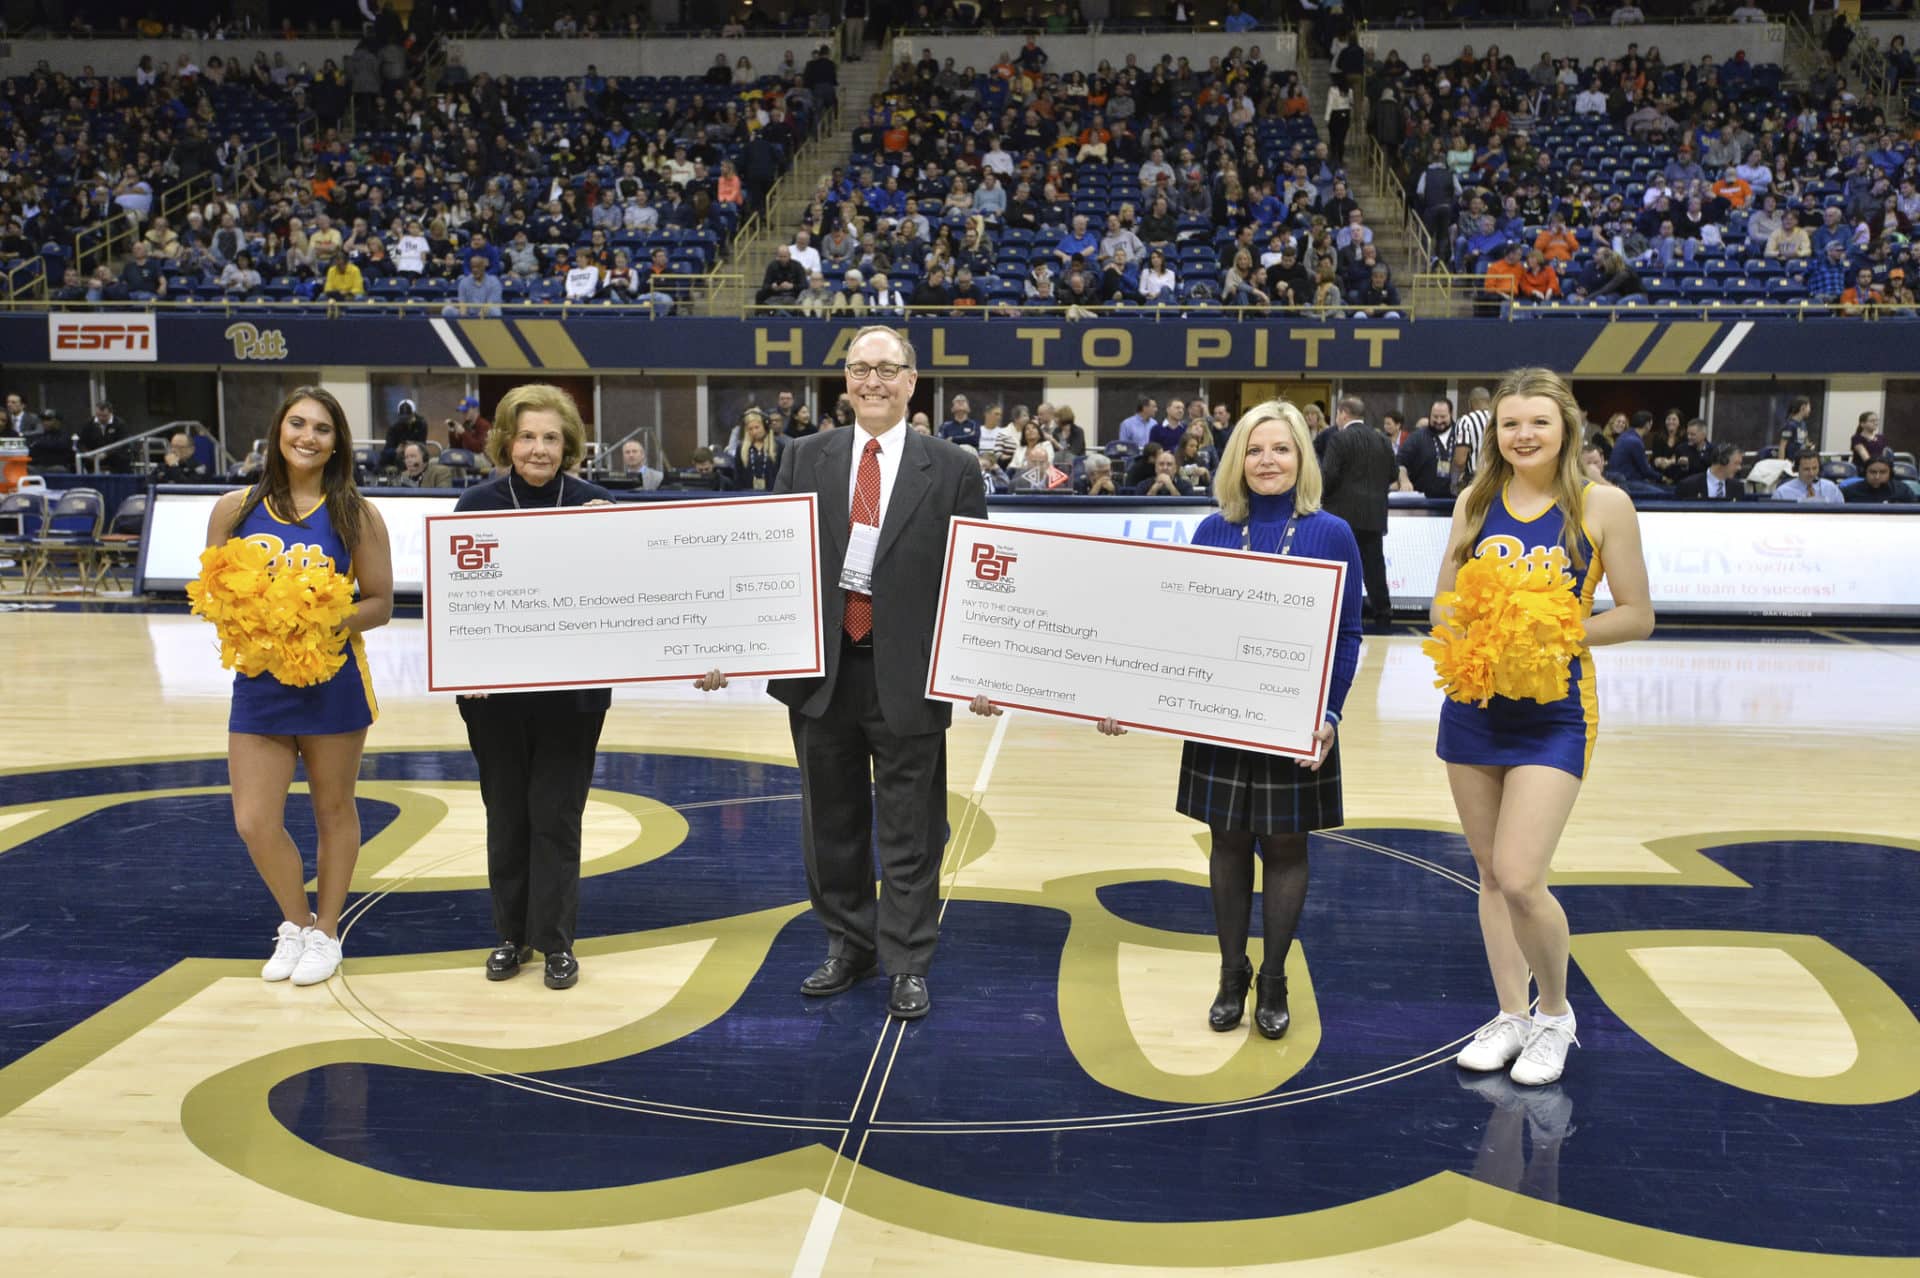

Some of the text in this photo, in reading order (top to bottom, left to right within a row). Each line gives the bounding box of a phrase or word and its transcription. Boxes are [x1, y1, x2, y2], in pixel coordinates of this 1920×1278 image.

[57, 325, 150, 349] ESPN
[225, 322, 288, 360] Pitt
[755, 327, 1400, 368] HAL TO PITT
[674, 532, 728, 545] February
[731, 530, 762, 543] 24th,
[765, 528, 795, 540] 2018
[450, 534, 499, 570] PGT
[971, 543, 1017, 581] PGT
[448, 570, 503, 581] TRUCKING
[966, 579, 1016, 593] TRUCKING
[448, 591, 463, 599] PAY
[480, 590, 495, 598] THE
[496, 588, 526, 597] ORDER
[448, 579, 796, 614] Stanley M. Marks, MD, Endowed Research Fund $15,750.00
[1160, 581, 1315, 608] DATE: February 24th, 2018
[757, 613, 797, 623] DOLLARS
[962, 599, 977, 607] PAY
[978, 601, 989, 609] TO
[991, 602, 1006, 612] THE
[1007, 605, 1035, 615] ORDER
[449, 613, 708, 637] Fifteen Thousand Seven Hundred and Fifty
[965, 610, 1098, 640] University of Pittsburgh
[664, 640, 770, 655] PGT Trucking, Inc.
[962, 633, 1214, 682] Fifteen Thousand Seven Hundred and Fifty
[1242, 643, 1306, 662] $15,750.00
[951, 674, 1077, 702] Memo: Athletic Department
[1259, 682, 1301, 696] DOLLARS
[1157, 694, 1267, 722] PGT Trucking, Inc.
